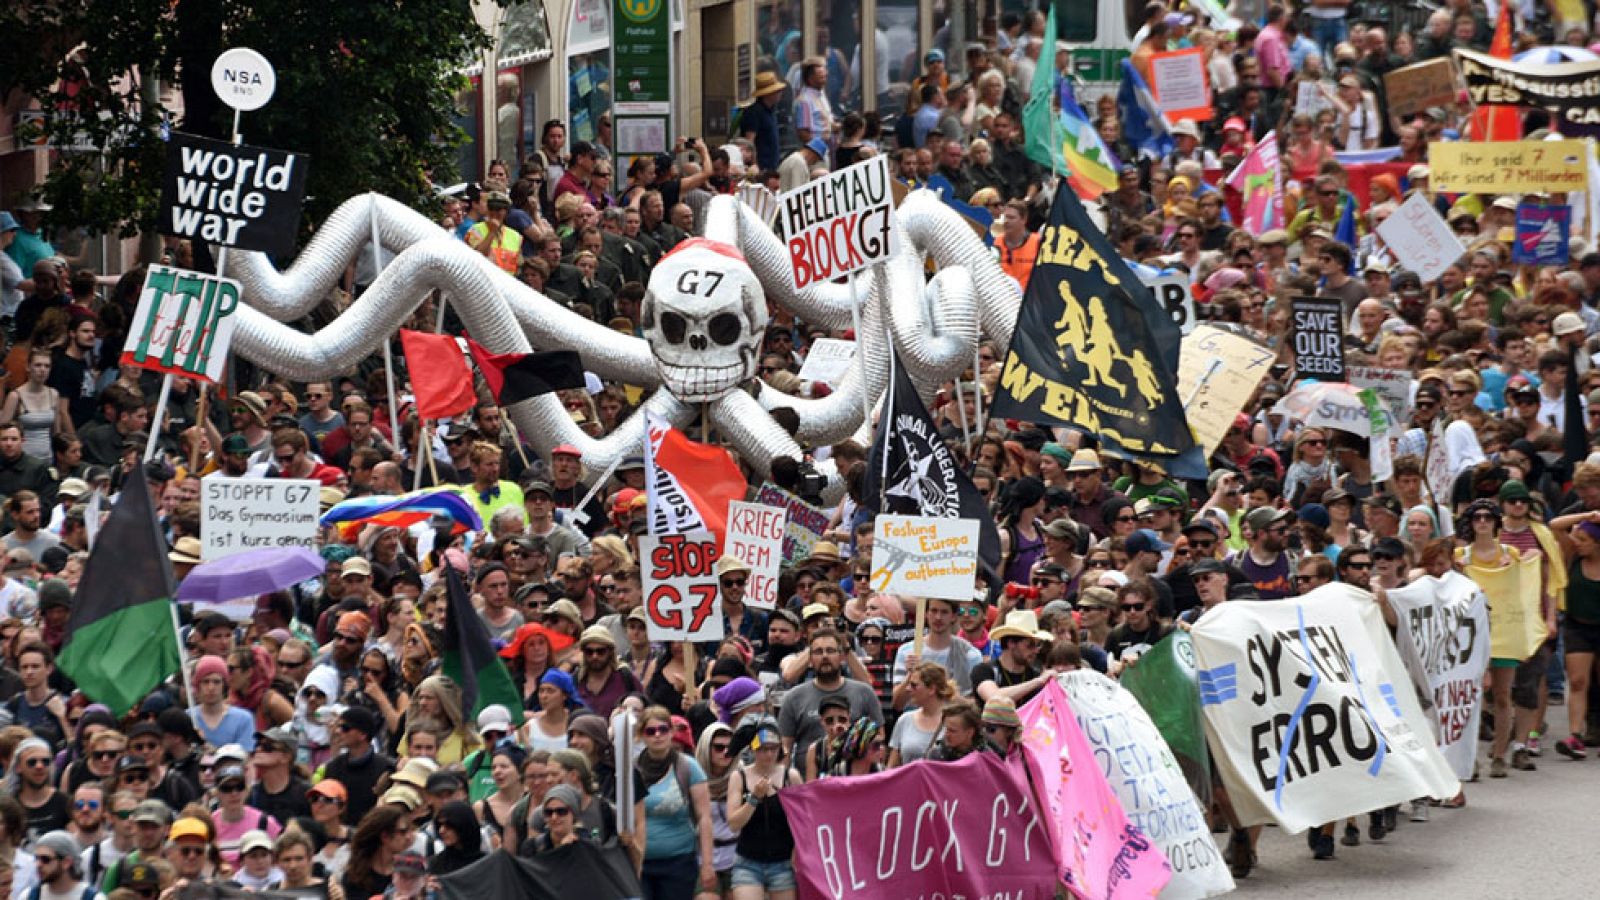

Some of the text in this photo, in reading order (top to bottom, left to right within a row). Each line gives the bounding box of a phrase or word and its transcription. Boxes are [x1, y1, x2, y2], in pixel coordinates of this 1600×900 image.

[223, 68, 263, 85] NSA
[181, 147, 295, 191] world
[1532, 148, 1545, 164] 7
[1502, 168, 1513, 183] 7
[177, 176, 266, 218] wide
[172, 206, 248, 245] war
[677, 270, 724, 297] G7
[134, 268, 239, 374] TTIP
[1295, 311, 1337, 331] SAVE
[1296, 332, 1341, 357] OUR
[1298, 355, 1343, 375] SEEDS
[928, 432, 961, 520] LIBERATIO
[208, 483, 312, 504] STOPPT G7
[208, 505, 314, 526] Das Gymnasium
[730, 507, 782, 540] KRIEG
[209, 531, 232, 547] ist
[240, 531, 272, 547] kurz
[919, 535, 968, 555] Europa
[651, 535, 718, 580] STOP
[733, 541, 771, 568] DEM
[743, 575, 776, 603] IEG
[647, 584, 718, 633] G7
[1251, 695, 1393, 792] ERRO
[817, 799, 965, 900] BLOCK
